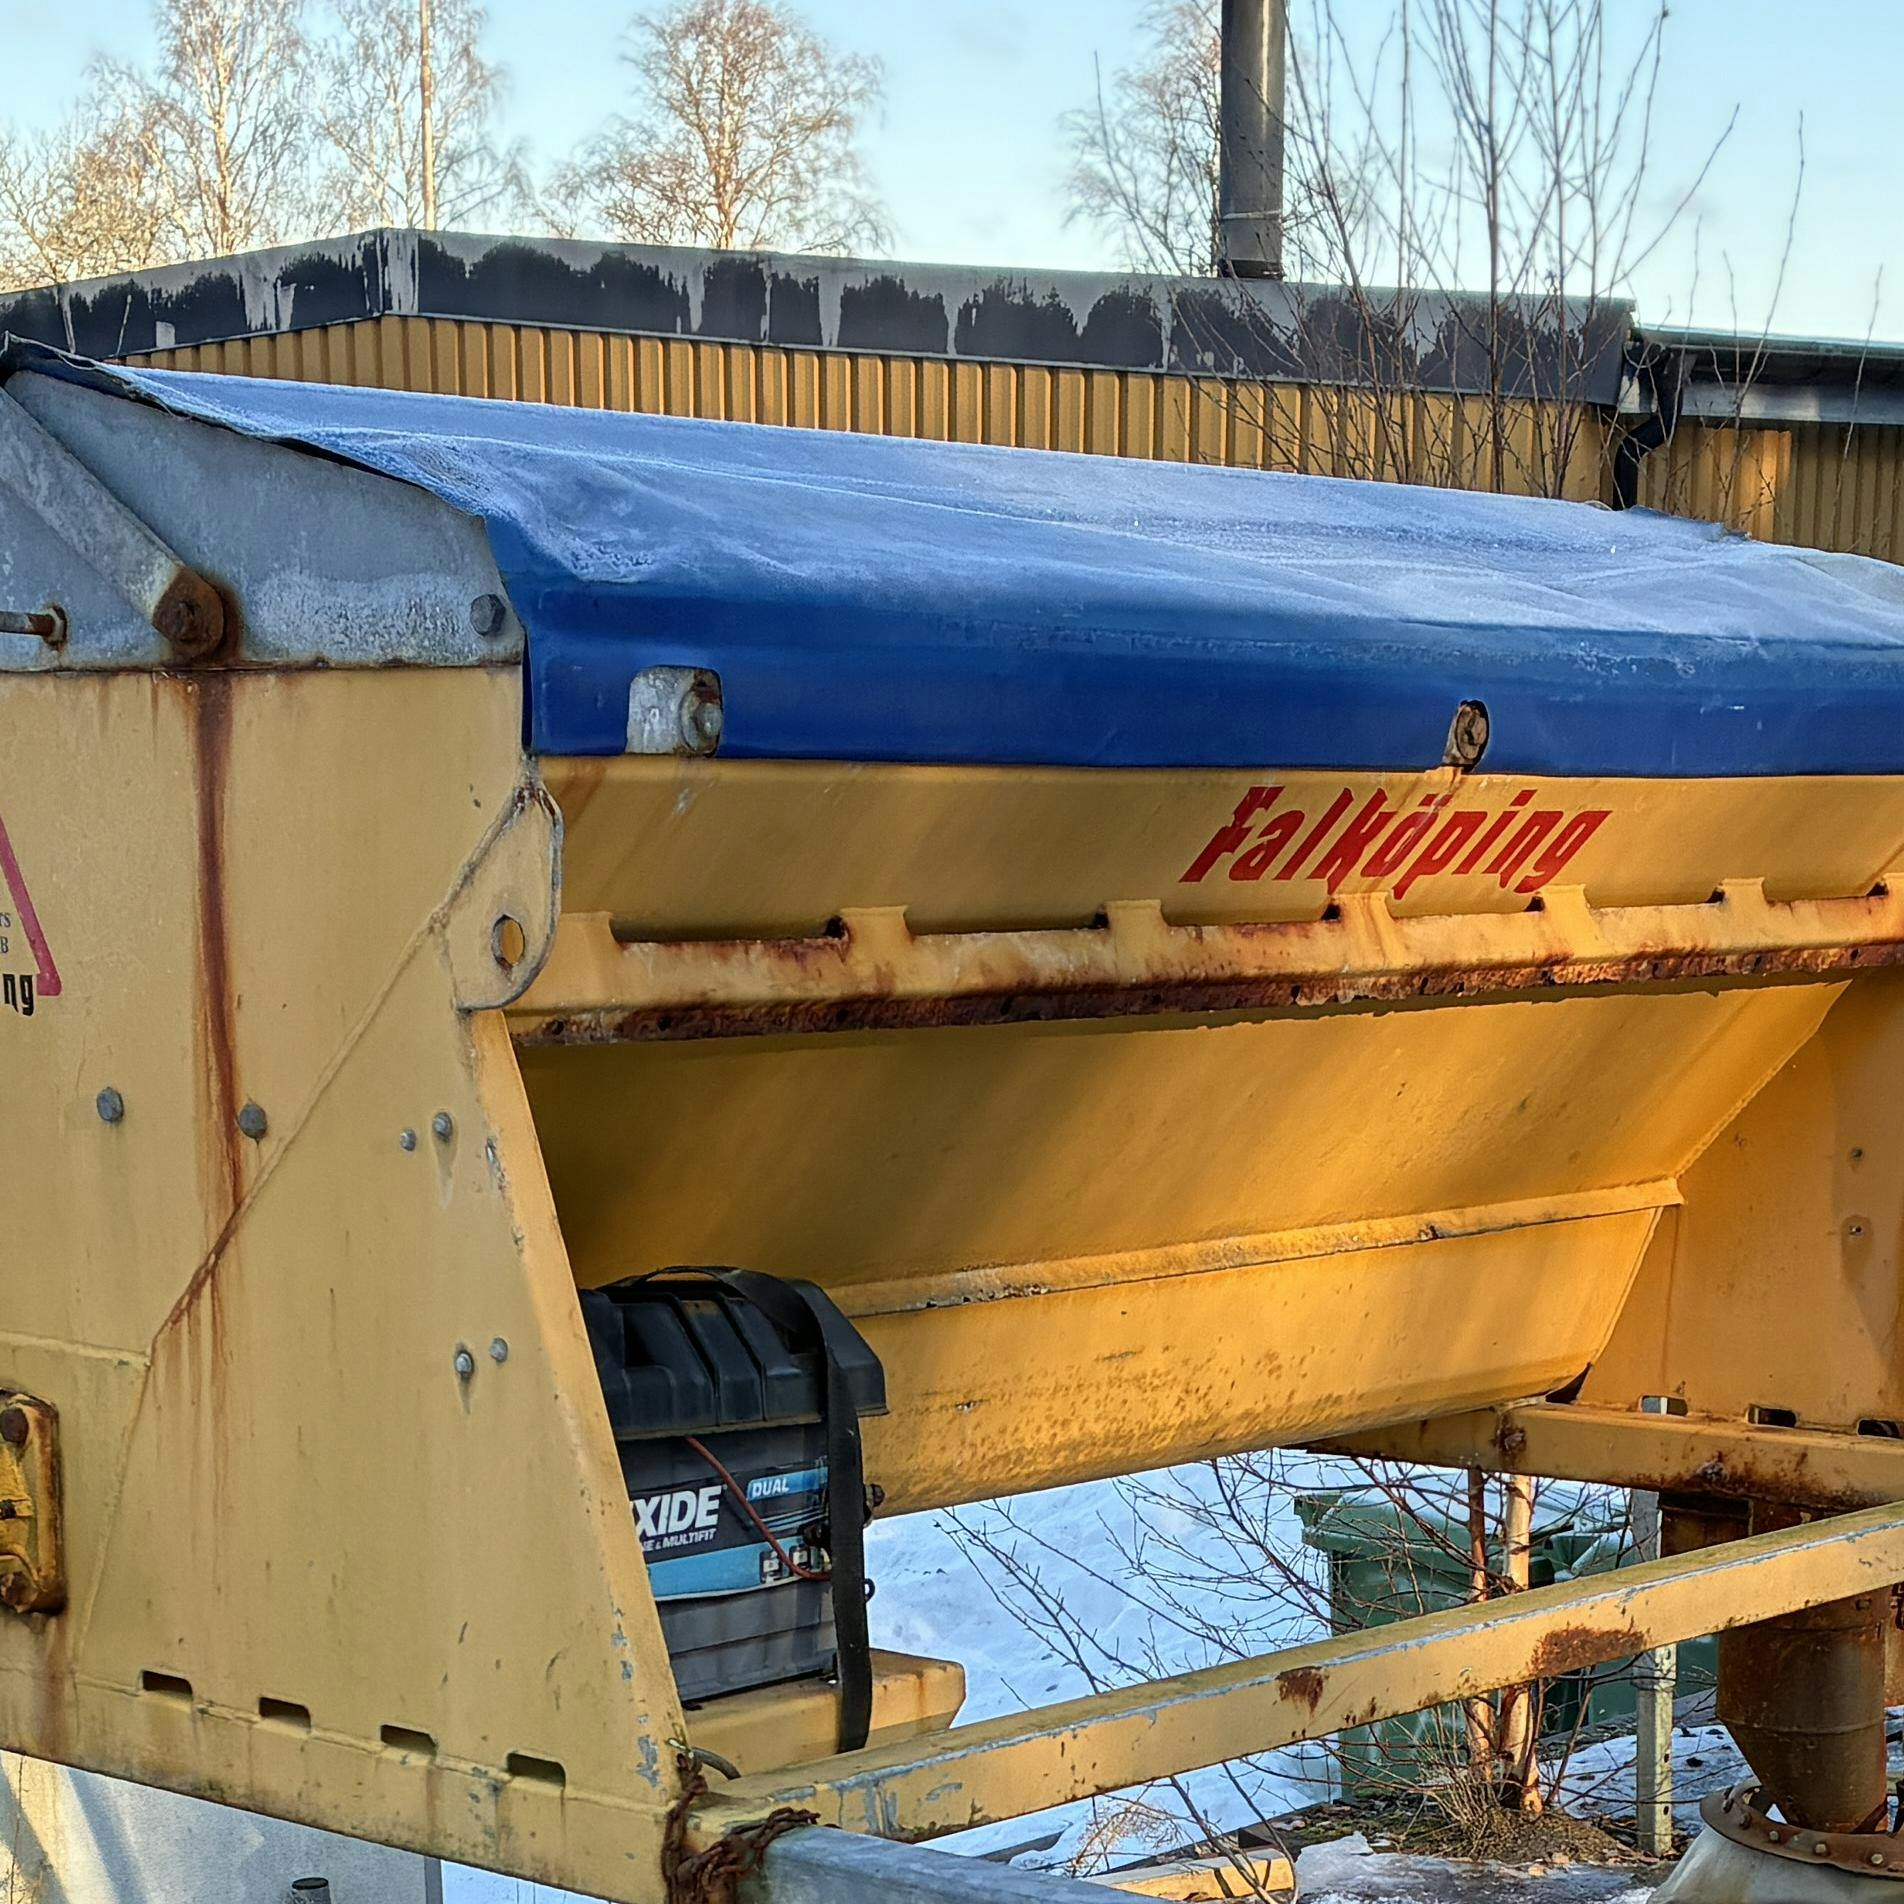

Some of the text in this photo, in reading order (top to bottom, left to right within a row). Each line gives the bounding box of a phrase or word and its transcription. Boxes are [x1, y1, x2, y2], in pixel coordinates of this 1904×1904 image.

[1179, 786, 1613, 899] Falköping
[751, 1478, 790, 1497] DUAL
[630, 1485, 722, 1537] XIDE
[662, 1528, 717, 1548] MULTIFIT
